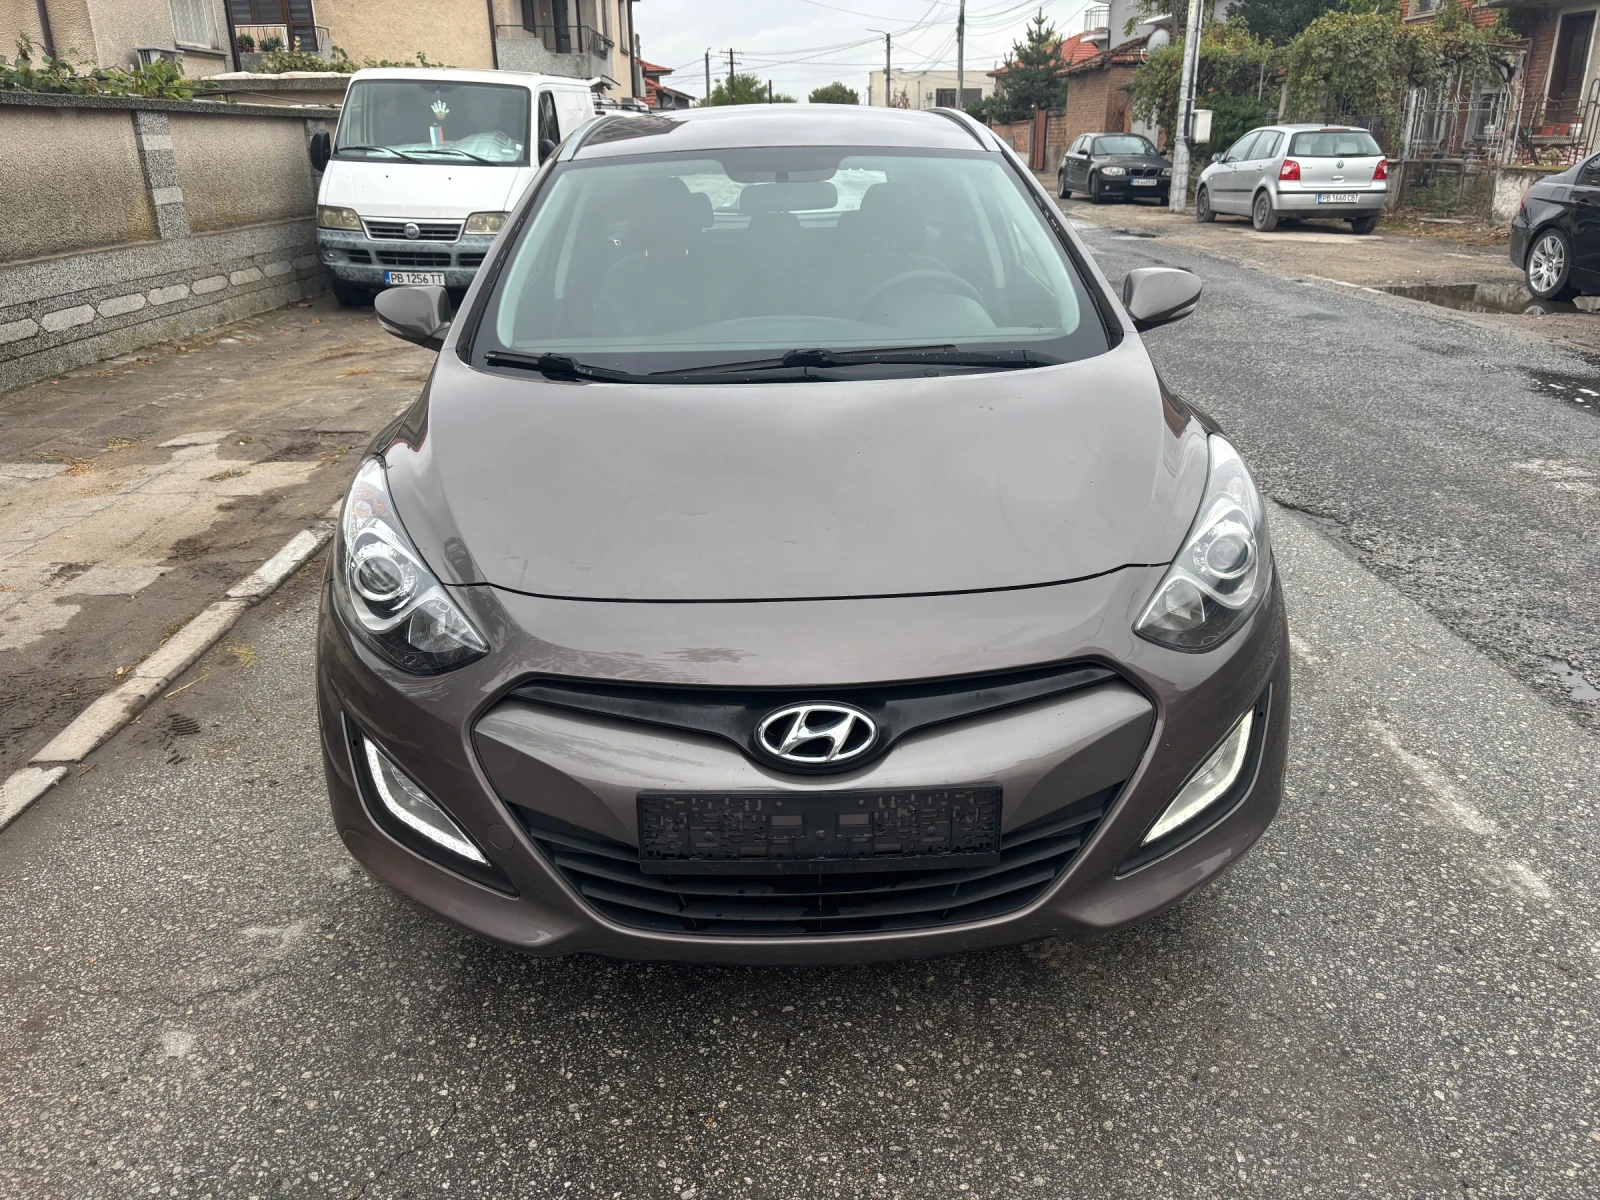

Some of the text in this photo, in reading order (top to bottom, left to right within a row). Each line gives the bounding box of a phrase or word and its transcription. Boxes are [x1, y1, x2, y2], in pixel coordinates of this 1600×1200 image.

[390, 273, 442, 284] PB 1256 TT
